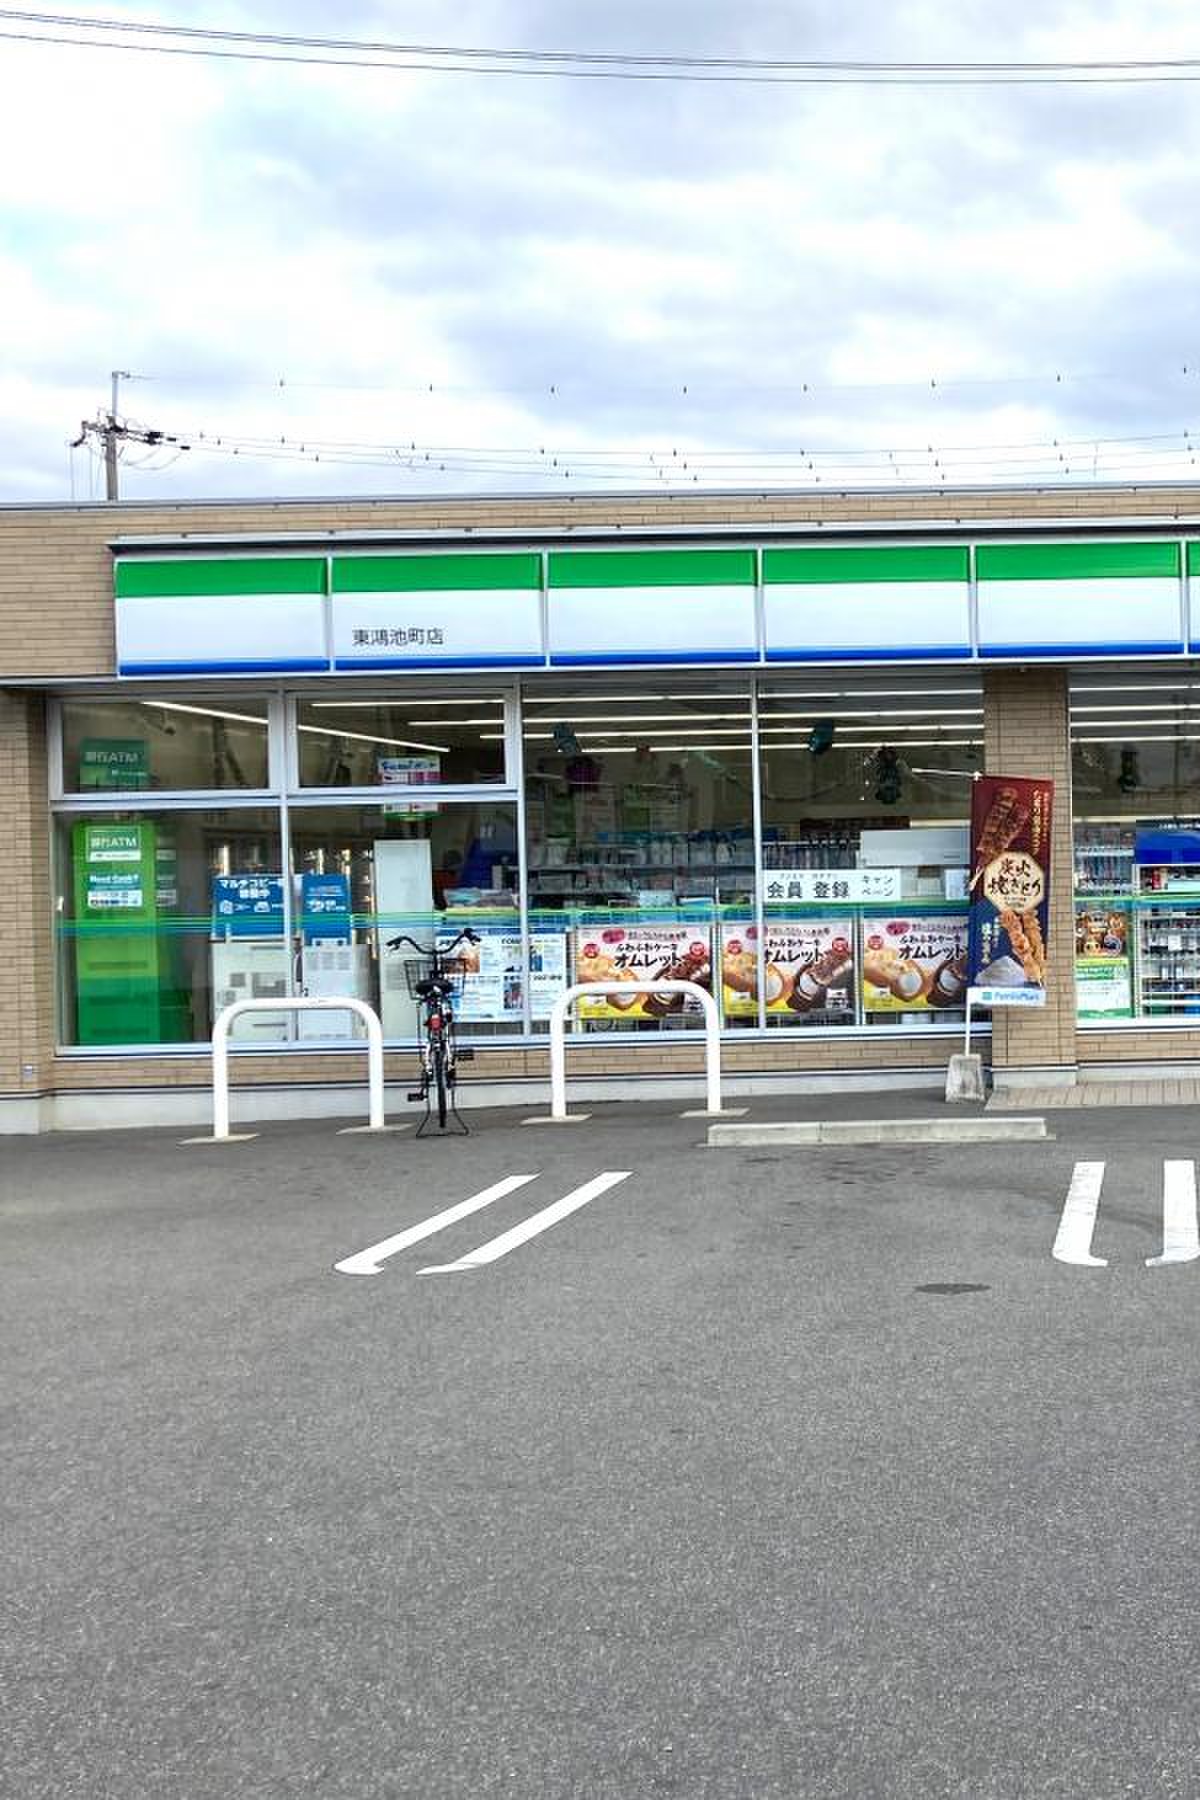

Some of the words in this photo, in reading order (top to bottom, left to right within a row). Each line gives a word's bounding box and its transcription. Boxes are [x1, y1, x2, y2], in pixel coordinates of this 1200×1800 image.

[767, 881, 802, 899] 会員
[813, 881, 849, 899] 登録
[764, 939, 821, 947] わふわケーキ
[614, 952, 682, 968] オムレット
[899, 944, 965, 960] オムレット
